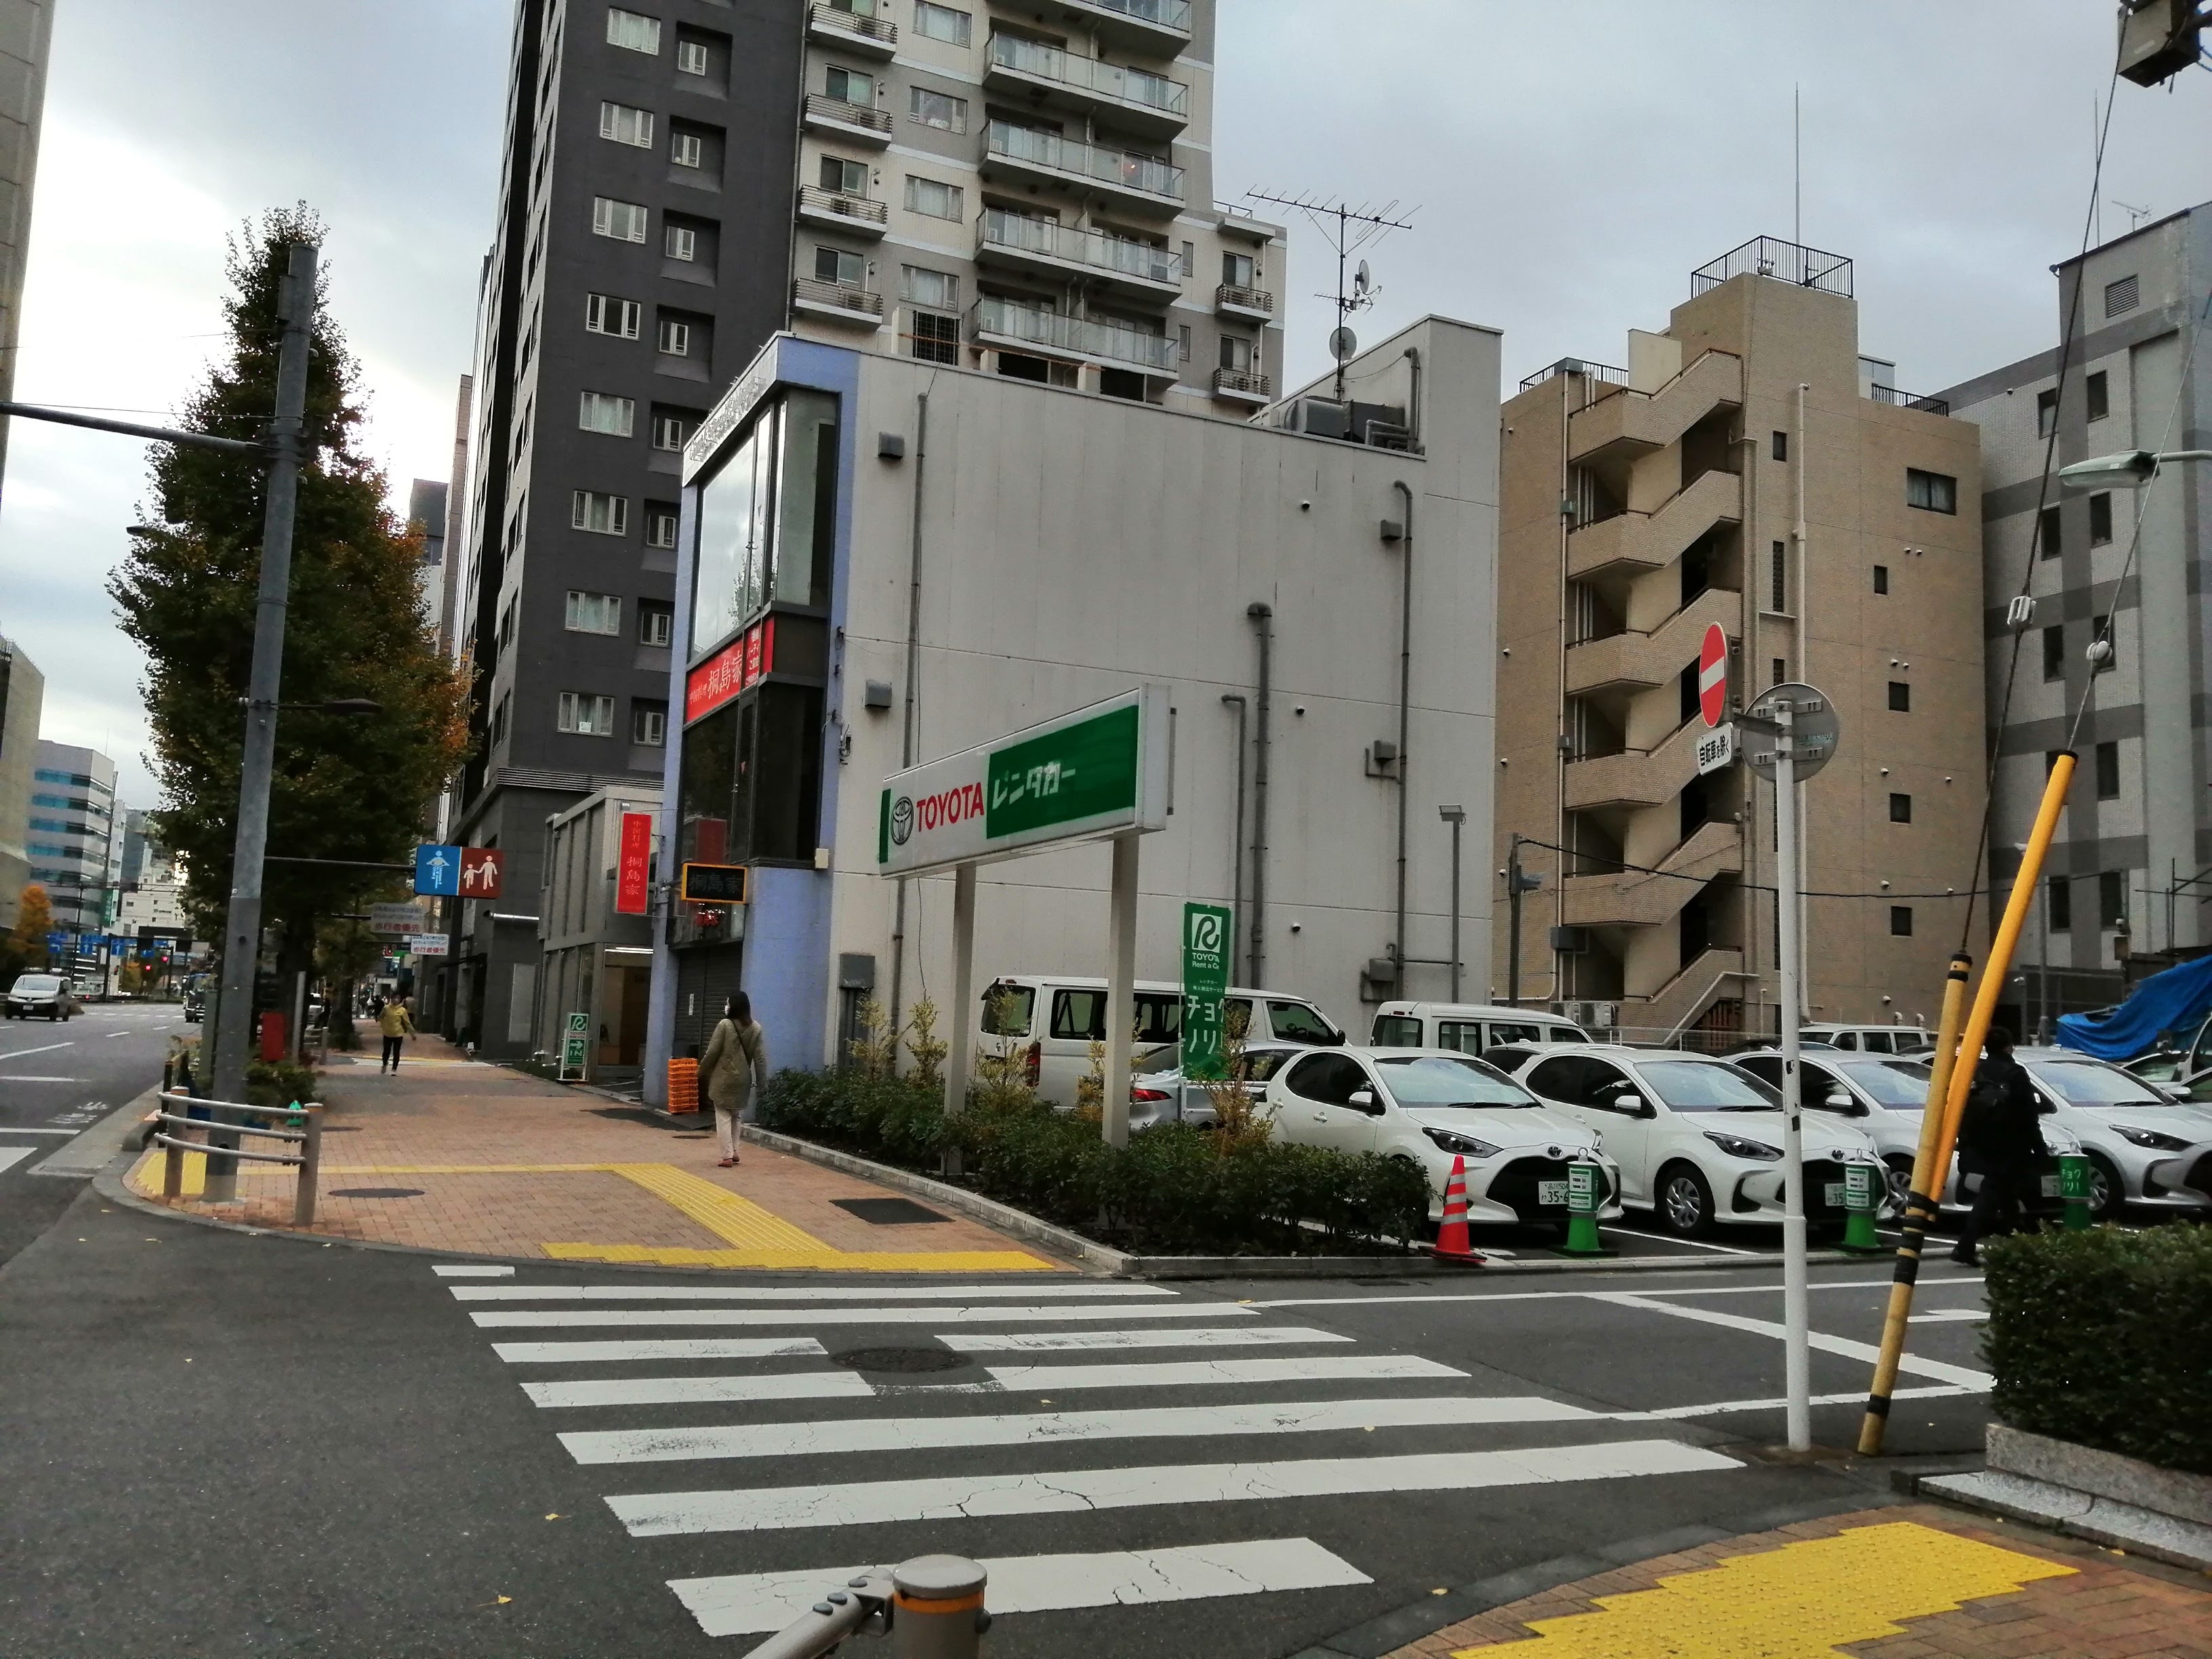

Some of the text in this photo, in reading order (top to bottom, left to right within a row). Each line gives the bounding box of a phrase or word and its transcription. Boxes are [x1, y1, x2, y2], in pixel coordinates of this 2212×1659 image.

[708, 650, 742, 699] 桐島家
[1700, 734, 1729, 766] 自転車を除く
[991, 760, 1076, 811] レンタカー
[916, 782, 985, 832] TOYOTA
[626, 856, 642, 895] 桐島家
[1192, 952, 1220, 962] TOYOTA
[1548, 1191, 1568, 1202] 35-6
